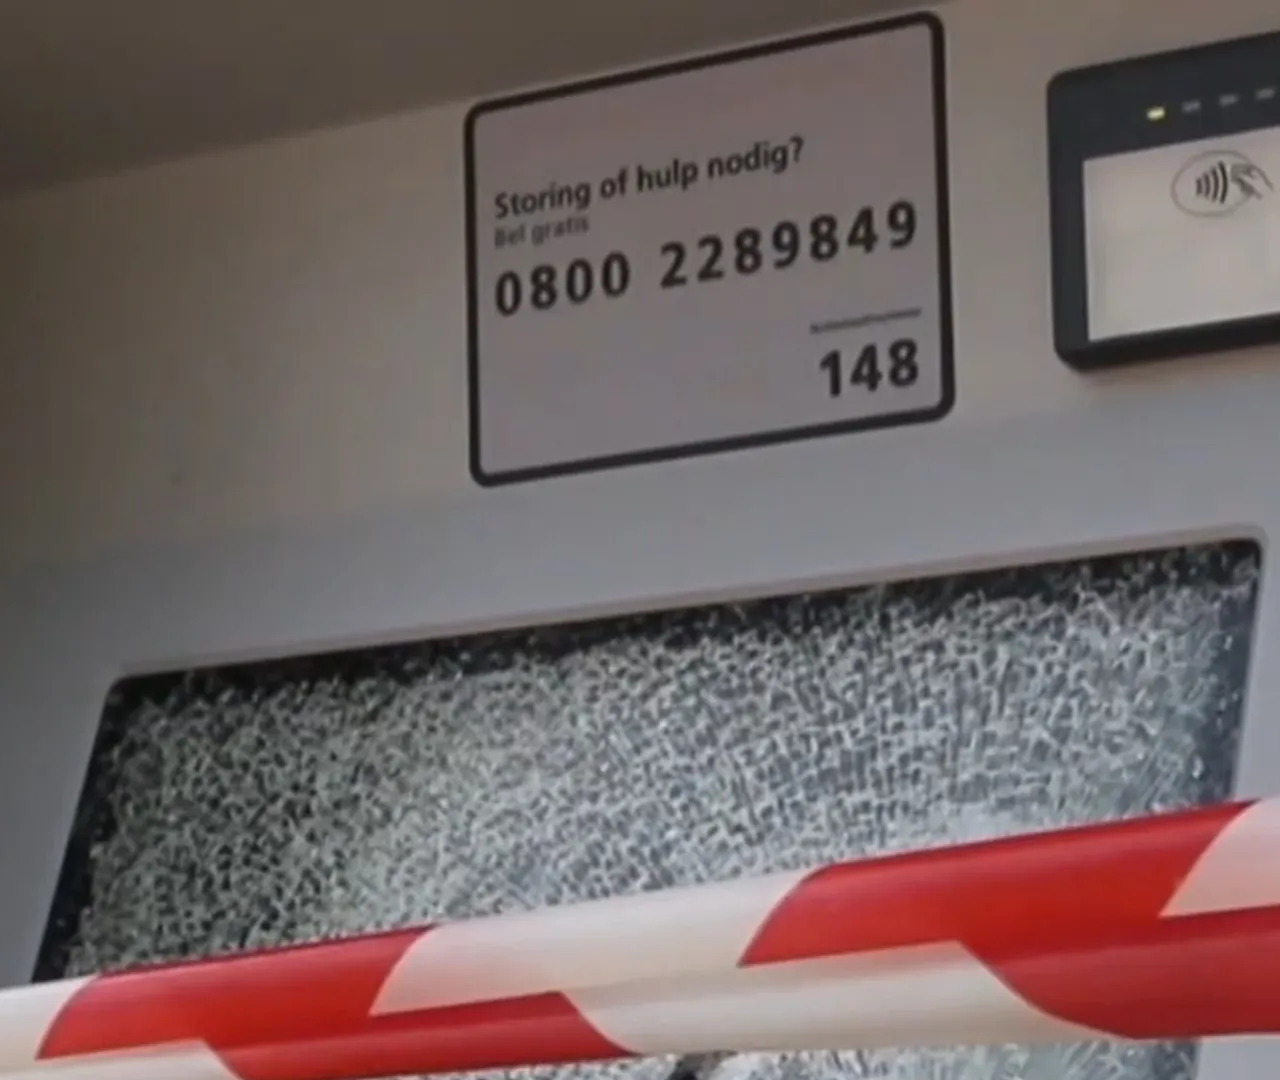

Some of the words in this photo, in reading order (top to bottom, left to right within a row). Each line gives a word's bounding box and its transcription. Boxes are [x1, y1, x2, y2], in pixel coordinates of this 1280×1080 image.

[493, 180, 591, 220] Storing
[599, 168, 628, 196] of
[637, 158, 699, 193] hulp
[707, 135, 804, 179] nodig?
[494, 223, 526, 250] Bel
[531, 214, 590, 245] gratis
[494, 251, 631, 317] 0800
[659, 200, 918, 290] 2289849
[819, 338, 920, 399] 148
